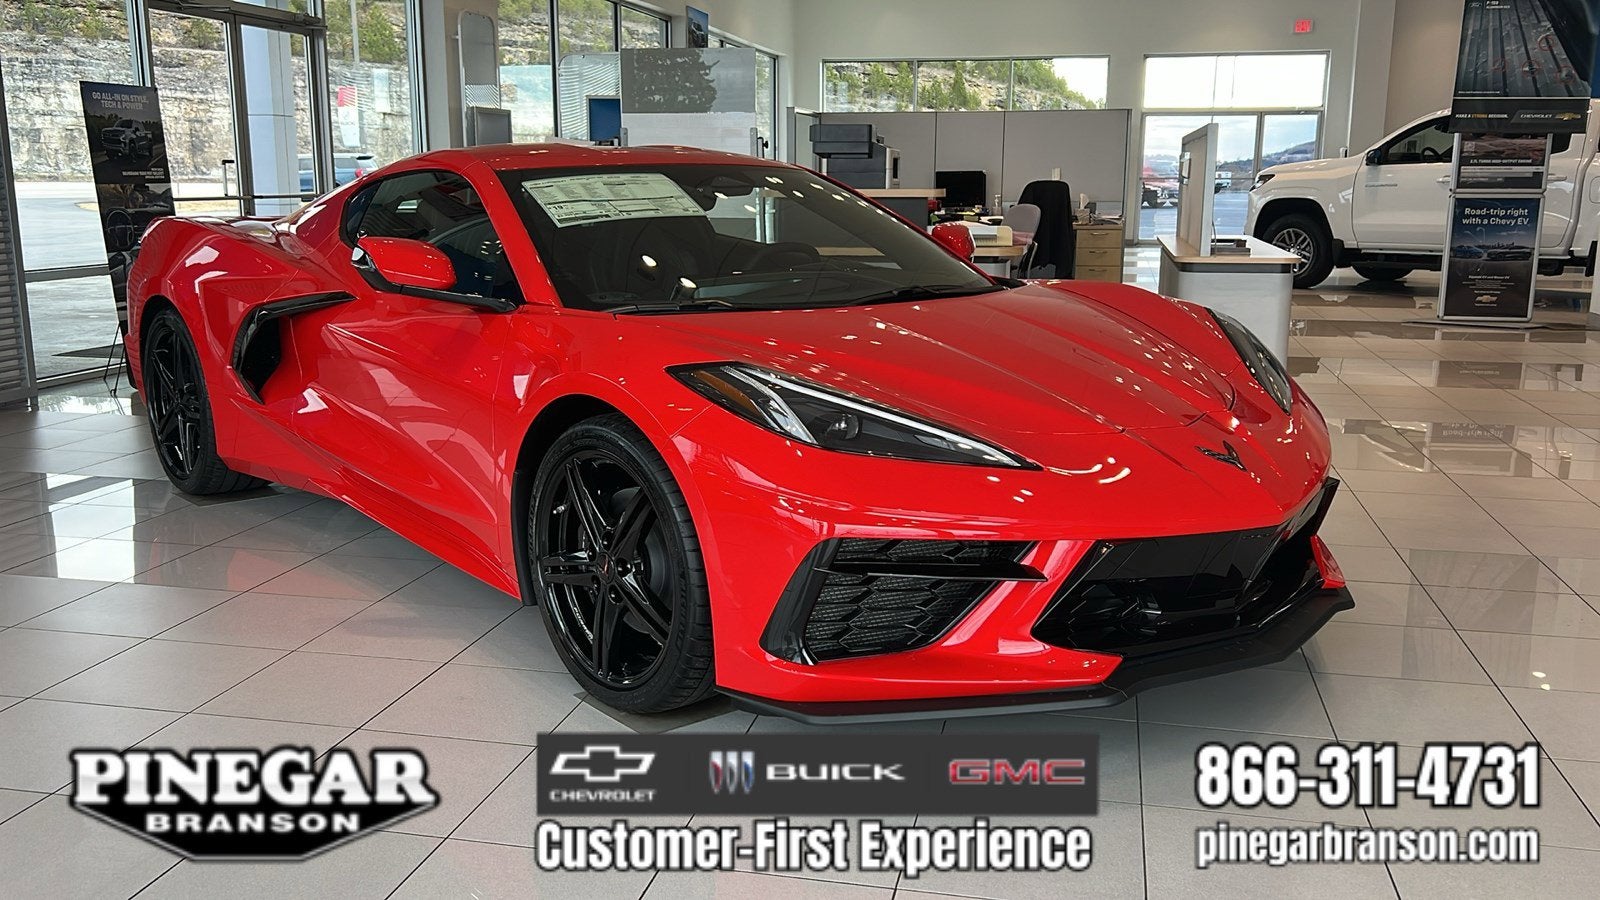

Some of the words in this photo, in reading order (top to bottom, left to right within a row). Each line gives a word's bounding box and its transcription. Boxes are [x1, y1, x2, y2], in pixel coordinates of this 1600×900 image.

[92, 91, 101, 100] GO
[101, 92, 121, 101] ALL-IN
[121, 94, 130, 102] ON
[101, 100, 117, 109] TECH
[122, 102, 144, 110] POWER
[1464, 207, 1506, 217] Road-trip
[1506, 207, 1529, 217] right
[1462, 217, 1481, 225] with
[1490, 217, 1517, 226] Chevy
[1517, 217, 1530, 225] EV
